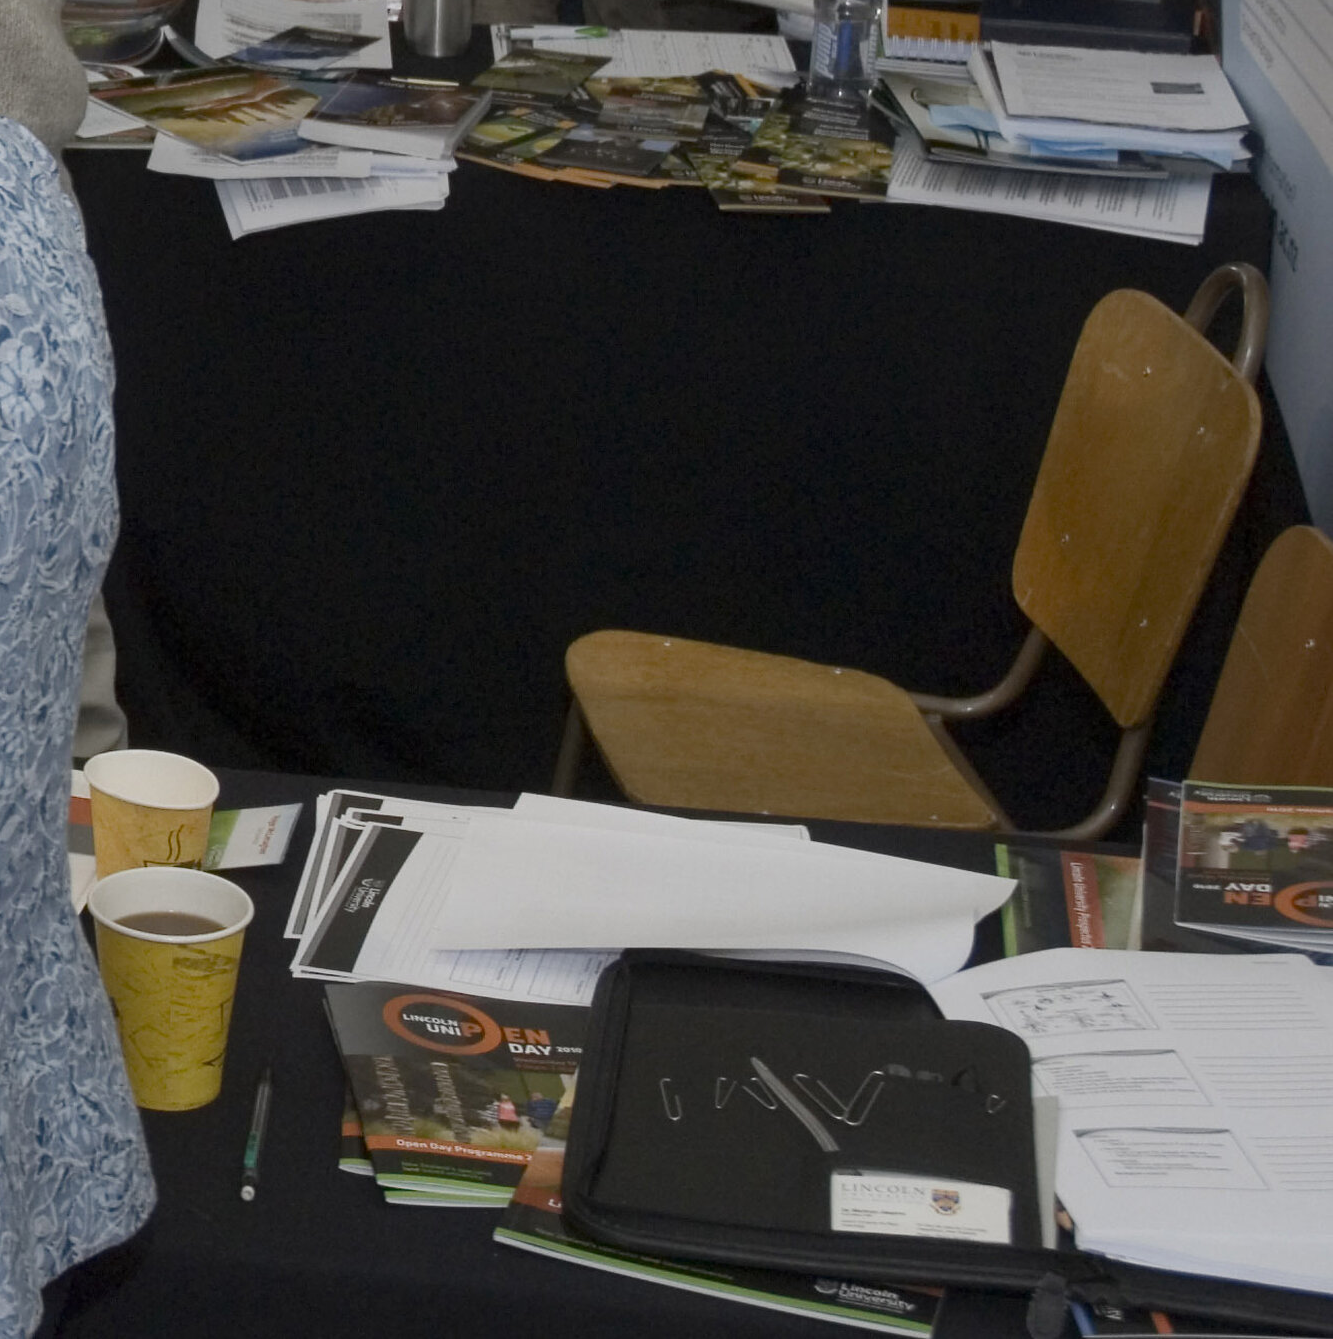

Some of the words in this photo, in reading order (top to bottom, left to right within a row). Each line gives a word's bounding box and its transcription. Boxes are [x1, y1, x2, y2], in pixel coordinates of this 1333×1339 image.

[1225, 882, 1273, 893] DAY
[402, 1013, 459, 1027] LINCOLN
[508, 1043, 552, 1056] DAY
[396, 1138, 427, 1150] Open
[429, 1142, 453, 1154] Day
[455, 1145, 522, 1161] Programme
[841, 1183, 926, 1196] LINCOLN
[840, 1282, 899, 1300] Lincoln
[838, 1289, 915, 1311] University
